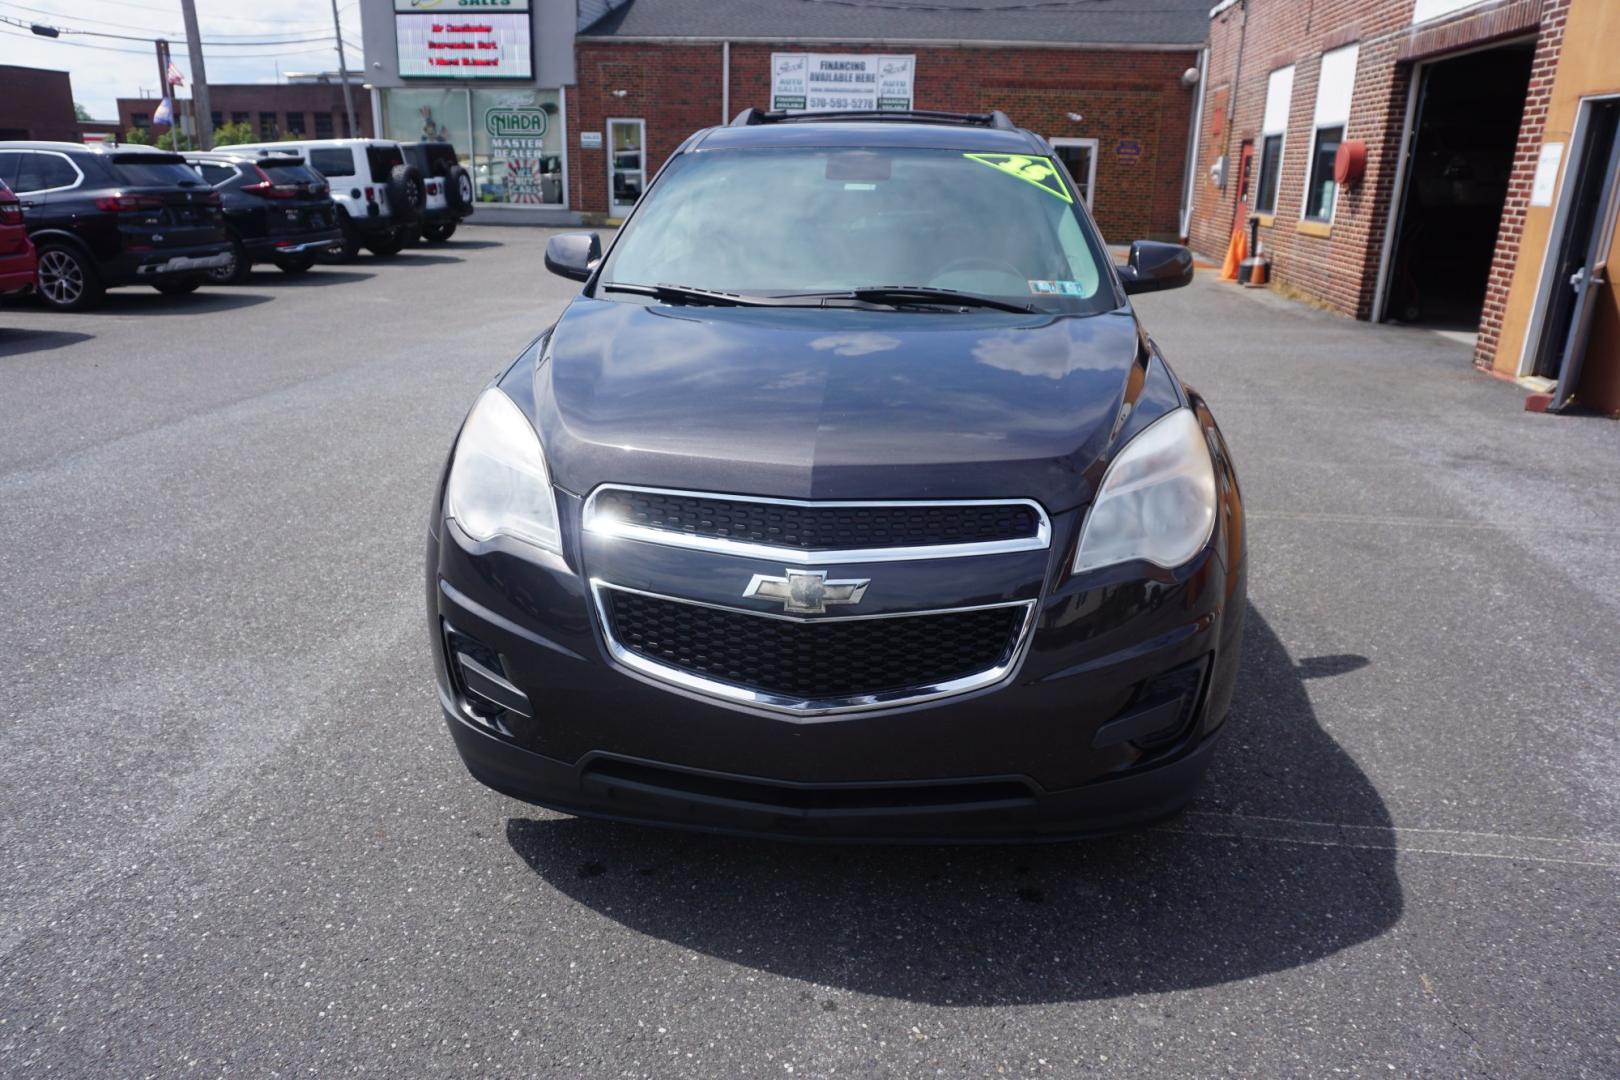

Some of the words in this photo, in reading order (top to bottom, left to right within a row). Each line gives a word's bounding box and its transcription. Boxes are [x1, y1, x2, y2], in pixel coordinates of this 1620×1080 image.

[820, 60, 866, 71] FINANCING
[809, 72, 853, 83] AVAILABLE
[855, 73, 876, 83] HERE
[491, 114, 541, 131] NIADA
[492, 138, 544, 148] MASTER
[494, 149, 542, 158] DEALER
